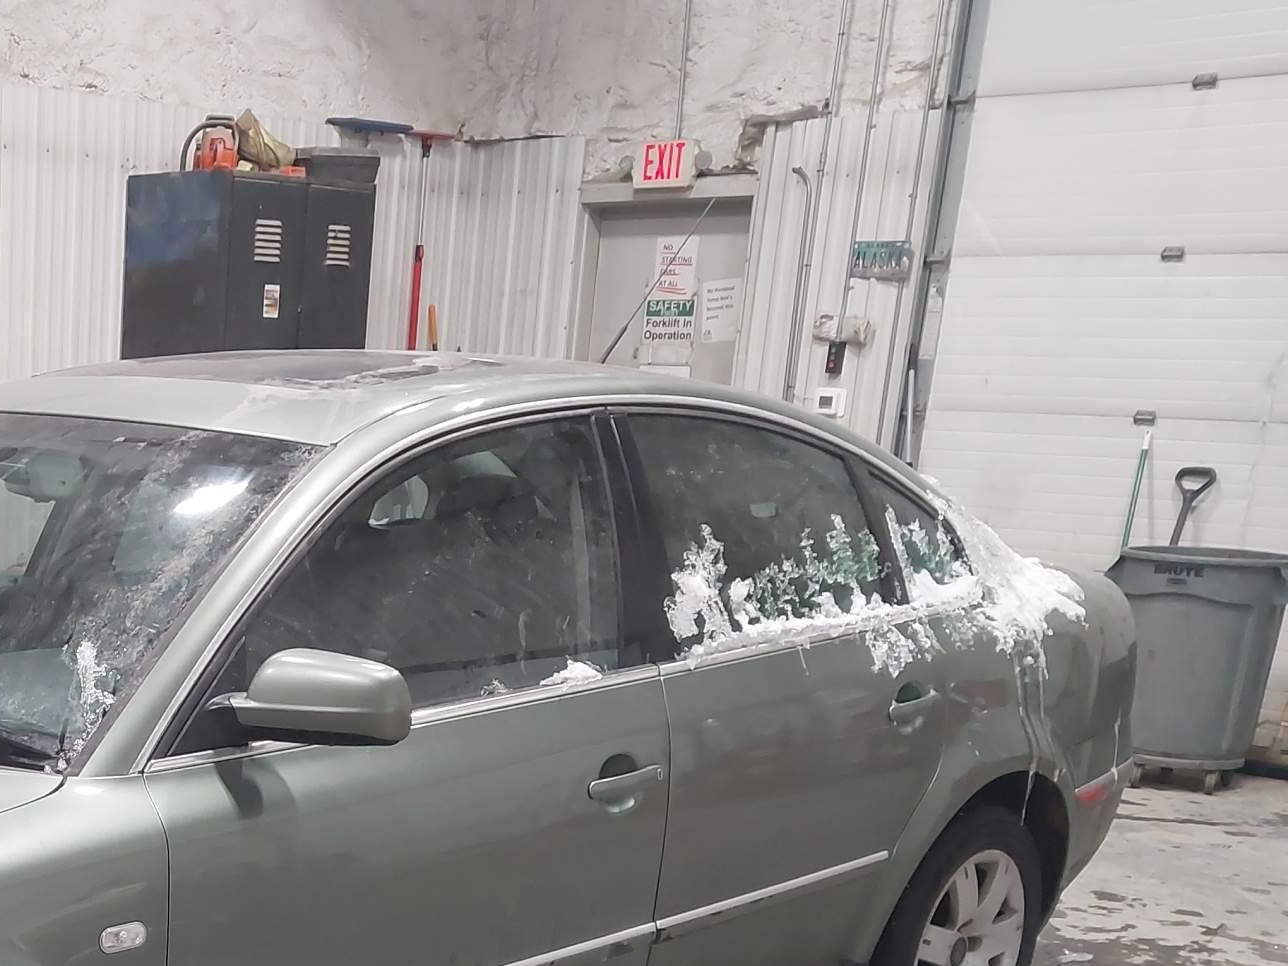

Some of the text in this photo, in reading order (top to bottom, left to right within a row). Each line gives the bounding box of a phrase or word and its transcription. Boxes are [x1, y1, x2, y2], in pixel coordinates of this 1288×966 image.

[642, 142, 685, 181] EXIT
[649, 300, 692, 312] SAFETY
[646, 318, 692, 328] Forklift In
[643, 330, 692, 342] Operation
